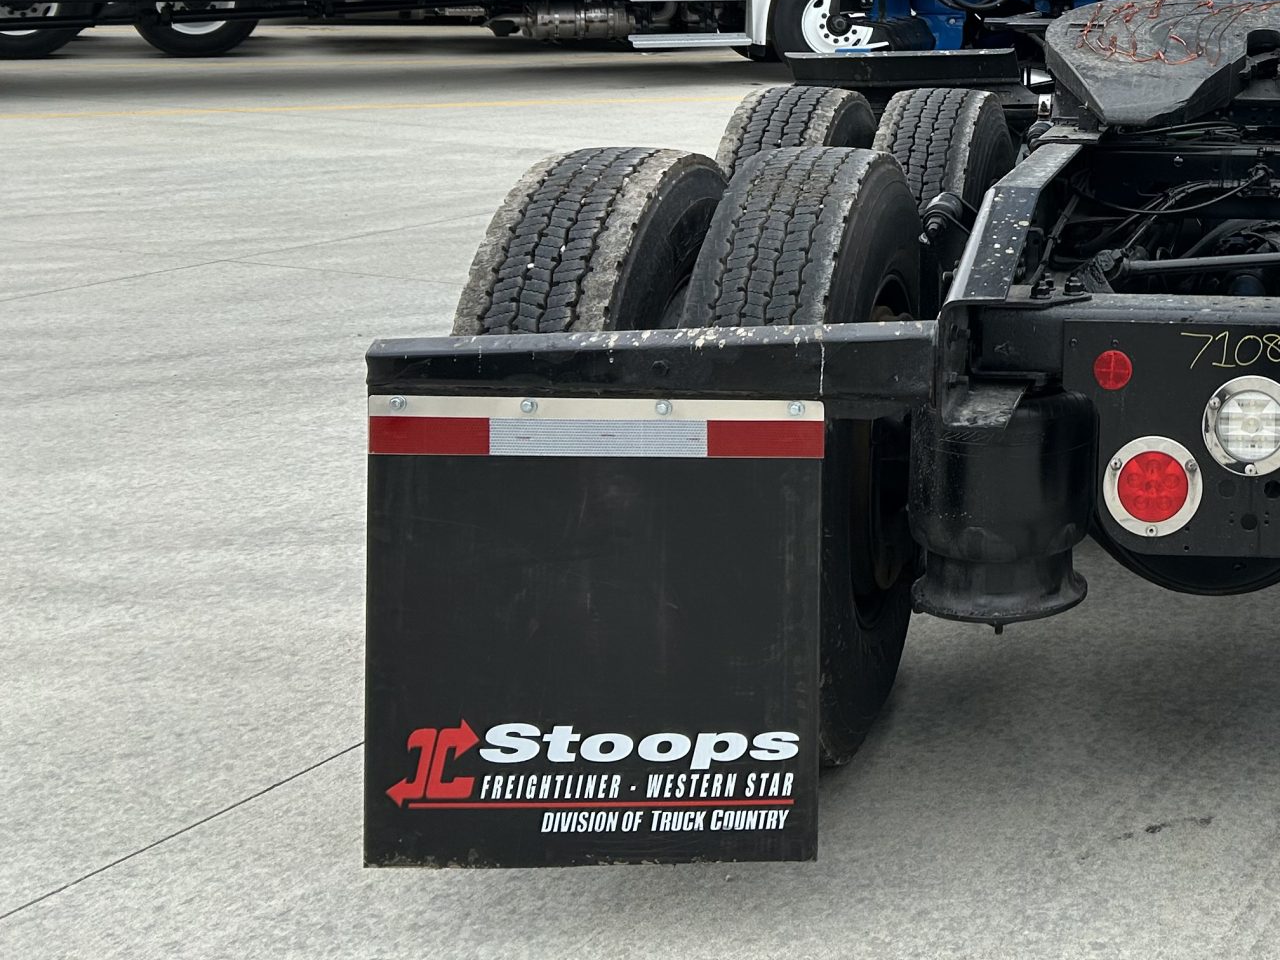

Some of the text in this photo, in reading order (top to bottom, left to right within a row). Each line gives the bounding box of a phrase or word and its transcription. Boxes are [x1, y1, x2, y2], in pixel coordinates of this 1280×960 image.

[479, 722, 800, 770] Stoops
[480, 774, 621, 800] FREIGHTLINER
[646, 773, 736, 799] WESTERN
[745, 772, 795, 798] STAR
[541, 809, 789, 833] DIVISION OF TRUCK COUNTRY
